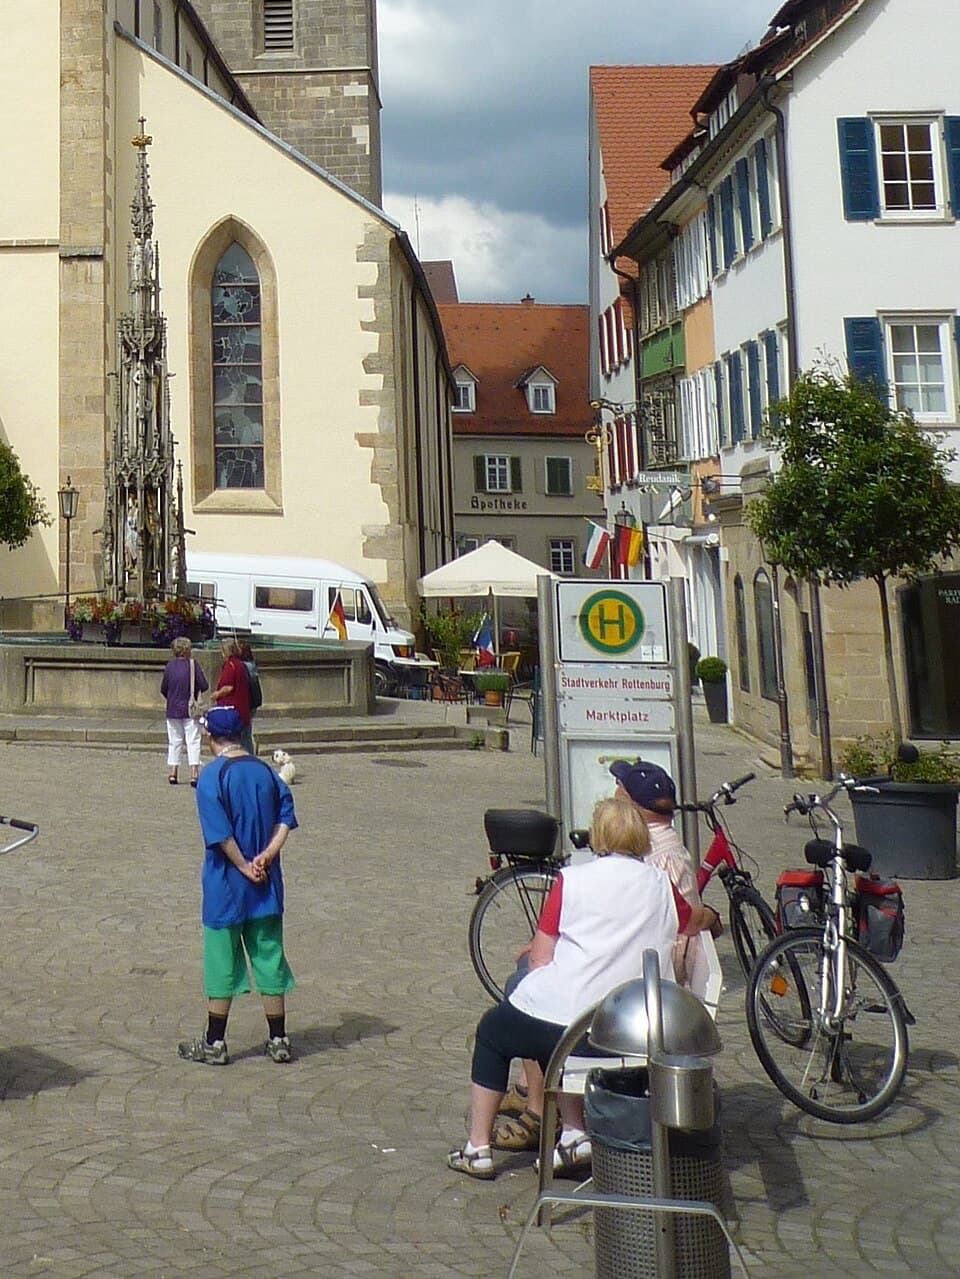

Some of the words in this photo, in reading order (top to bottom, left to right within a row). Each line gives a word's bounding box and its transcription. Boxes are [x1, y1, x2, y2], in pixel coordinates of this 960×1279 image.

[471, 496, 527, 511] Apotheke
[598, 604, 625, 640] H
[561, 677, 618, 689] Stadtverkehr
[622, 678, 671, 692] Rottenburg
[586, 710, 649, 724] Marktplatz
